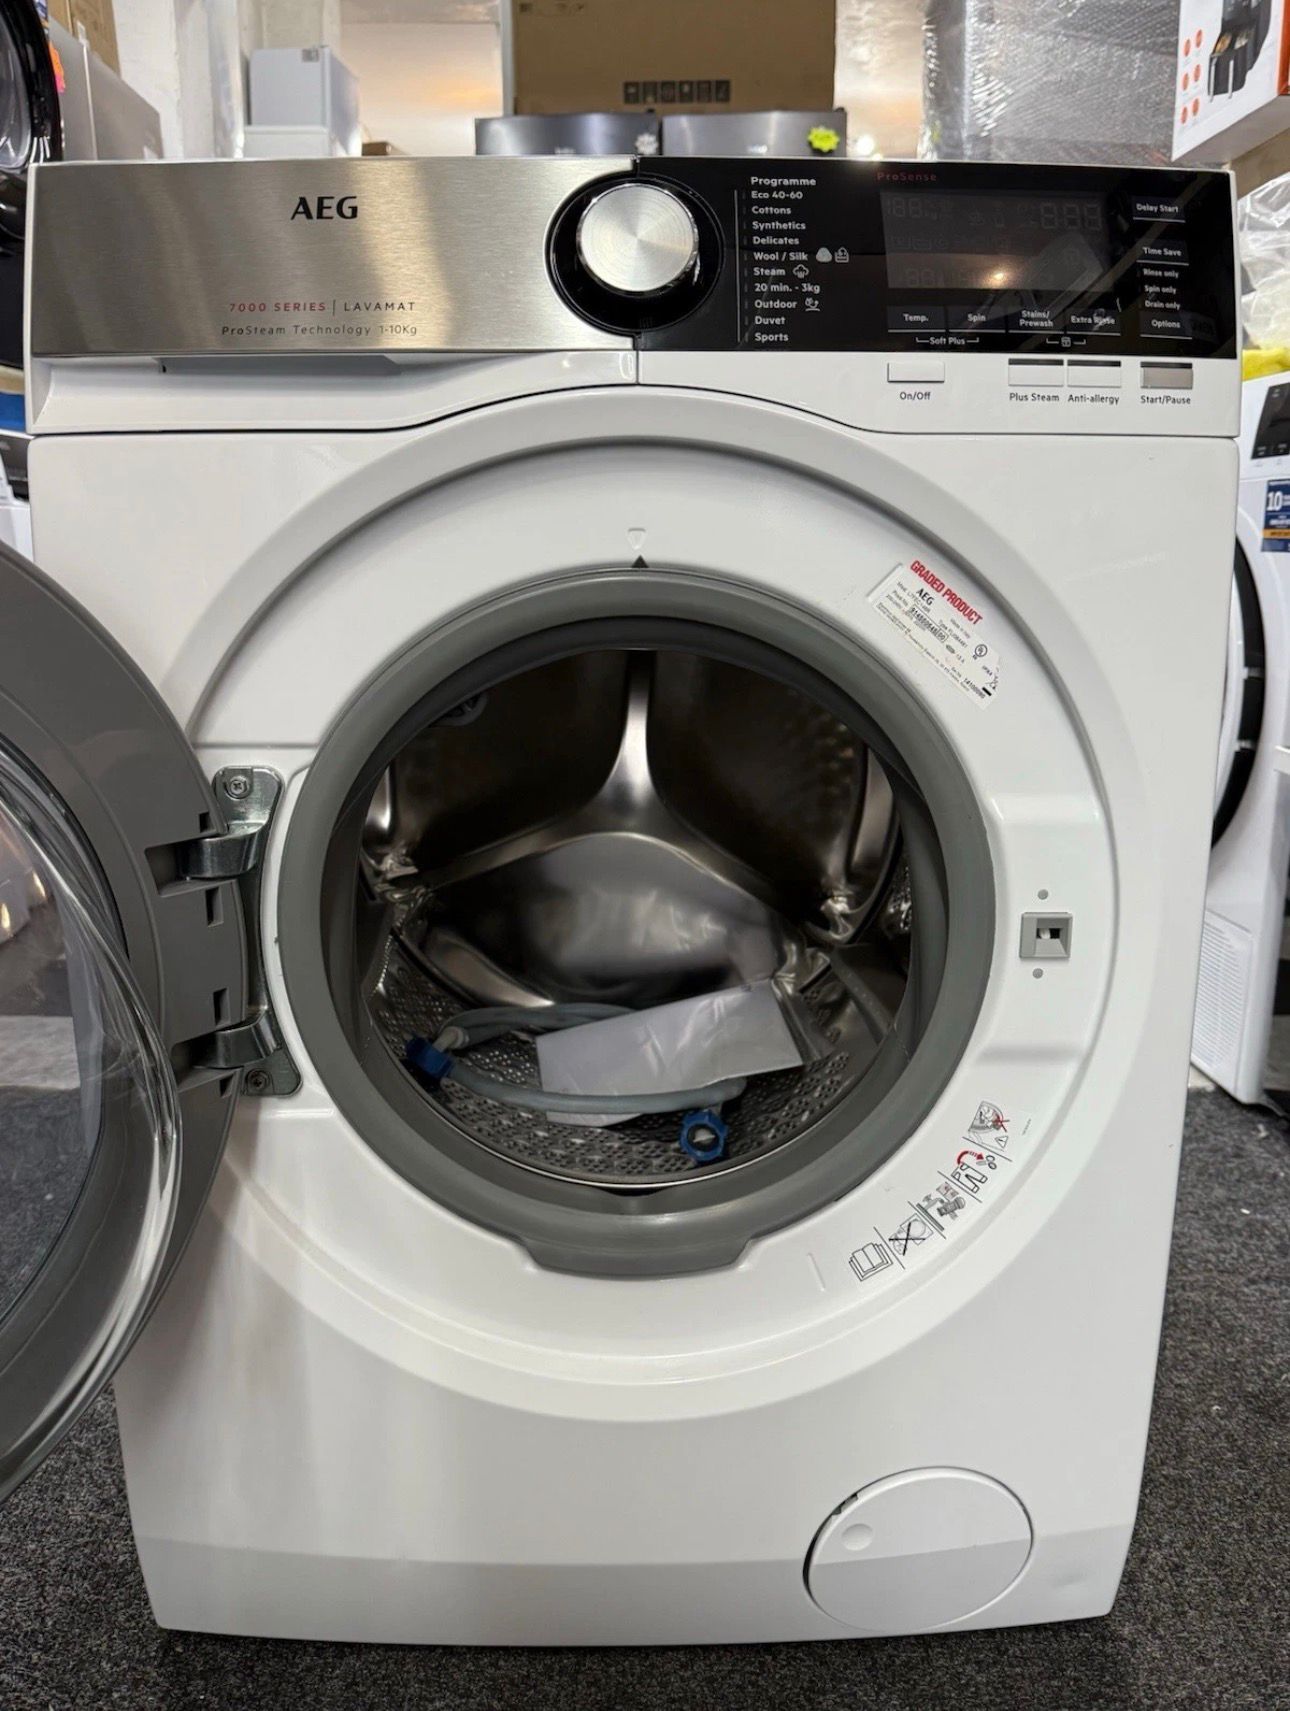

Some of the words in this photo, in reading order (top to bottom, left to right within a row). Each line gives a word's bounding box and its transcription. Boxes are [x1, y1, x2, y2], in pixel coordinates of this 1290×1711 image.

[750, 176, 816, 188] Programme
[876, 172, 937, 182] ProSense
[751, 190, 770, 199] Eco
[772, 190, 803, 199] 40-60
[291, 196, 358, 221] AEG
[751, 205, 792, 215] Cottons
[1136, 203, 1158, 212] Delay
[1160, 204, 1179, 213] Start
[752, 220, 806, 231] Synthetics
[753, 235, 800, 245] Delicates
[753, 252, 779, 261] Wool
[789, 252, 809, 261] Silk
[1142, 246, 1162, 255] Time
[1163, 248, 1182, 257] Save
[753, 267, 786, 276] Steam
[1143, 268, 1162, 277] Rinse
[1164, 270, 1179, 279] only
[754, 283, 768, 292] 20
[770, 283, 792, 292] min.
[801, 283, 820, 294] 3kg
[1144, 284, 1160, 294] Spin
[1161, 286, 1177, 295] only
[230, 303, 267, 312] 7000
[274, 302, 326, 312] SERIES
[344, 302, 415, 312] LAVAMAT
[754, 299, 798, 309] Outdoor
[1144, 300, 1165, 309] Drain
[1165, 302, 1181, 311] only
[903, 313, 929, 323] Temp.
[967, 313, 986, 323] Spin
[1021, 309, 1050, 320] Stains/
[754, 315, 786, 325] Duvet
[1019, 318, 1054, 328] Prewash
[1070, 315, 1092, 325] Extra
[1151, 319, 1181, 329] Options
[221, 325, 286, 335] ProSteam
[293, 324, 371, 337] Technology
[379, 324, 417, 336] 1-10Kg
[754, 332, 789, 343] Sports
[929, 337, 947, 346] Soft
[948, 337, 966, 346] Plus
[900, 391, 931, 401] On/Off
[1009, 392, 1029, 402] Plus
[1031, 392, 1060, 402] Steam
[1067, 393, 1120, 405] Anti-allergy
[1140, 395, 1191, 405] Start/Pause
[1266, 491, 1283, 511] 10
[910, 560, 946, 593] GRADED
[942, 588, 984, 625] PRODUCT
[916, 588, 935, 606] AEG
